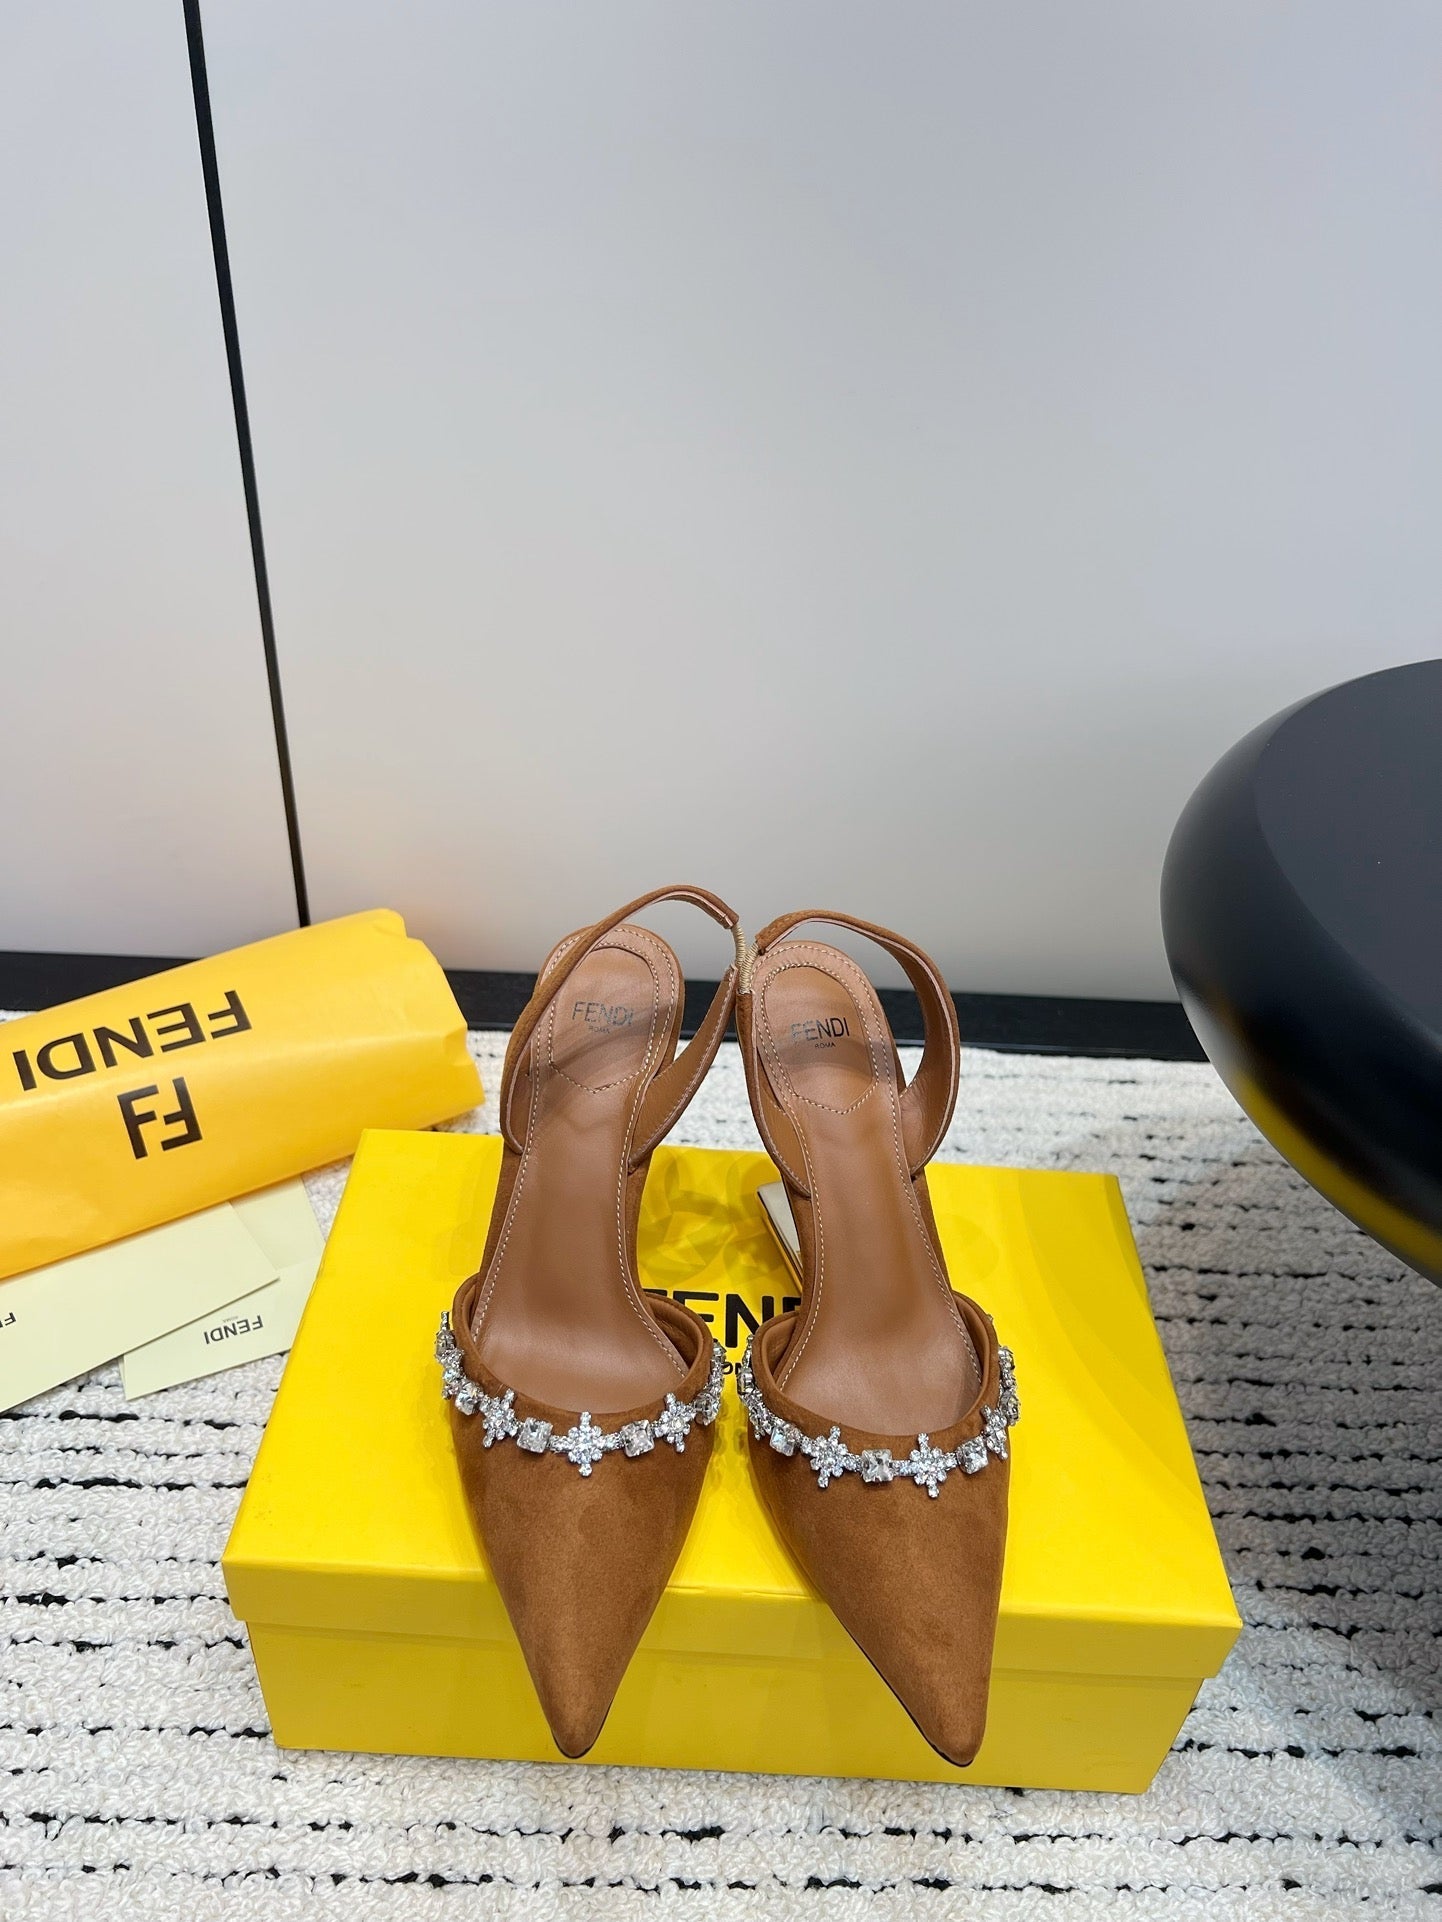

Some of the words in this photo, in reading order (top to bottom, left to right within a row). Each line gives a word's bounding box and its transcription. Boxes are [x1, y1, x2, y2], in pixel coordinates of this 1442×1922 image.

[572, 1001, 634, 1026] FENDI
[12, 990, 252, 1091] FENDI
[790, 1016, 850, 1042] FENDI
[203, 1314, 264, 1345] FENDI
